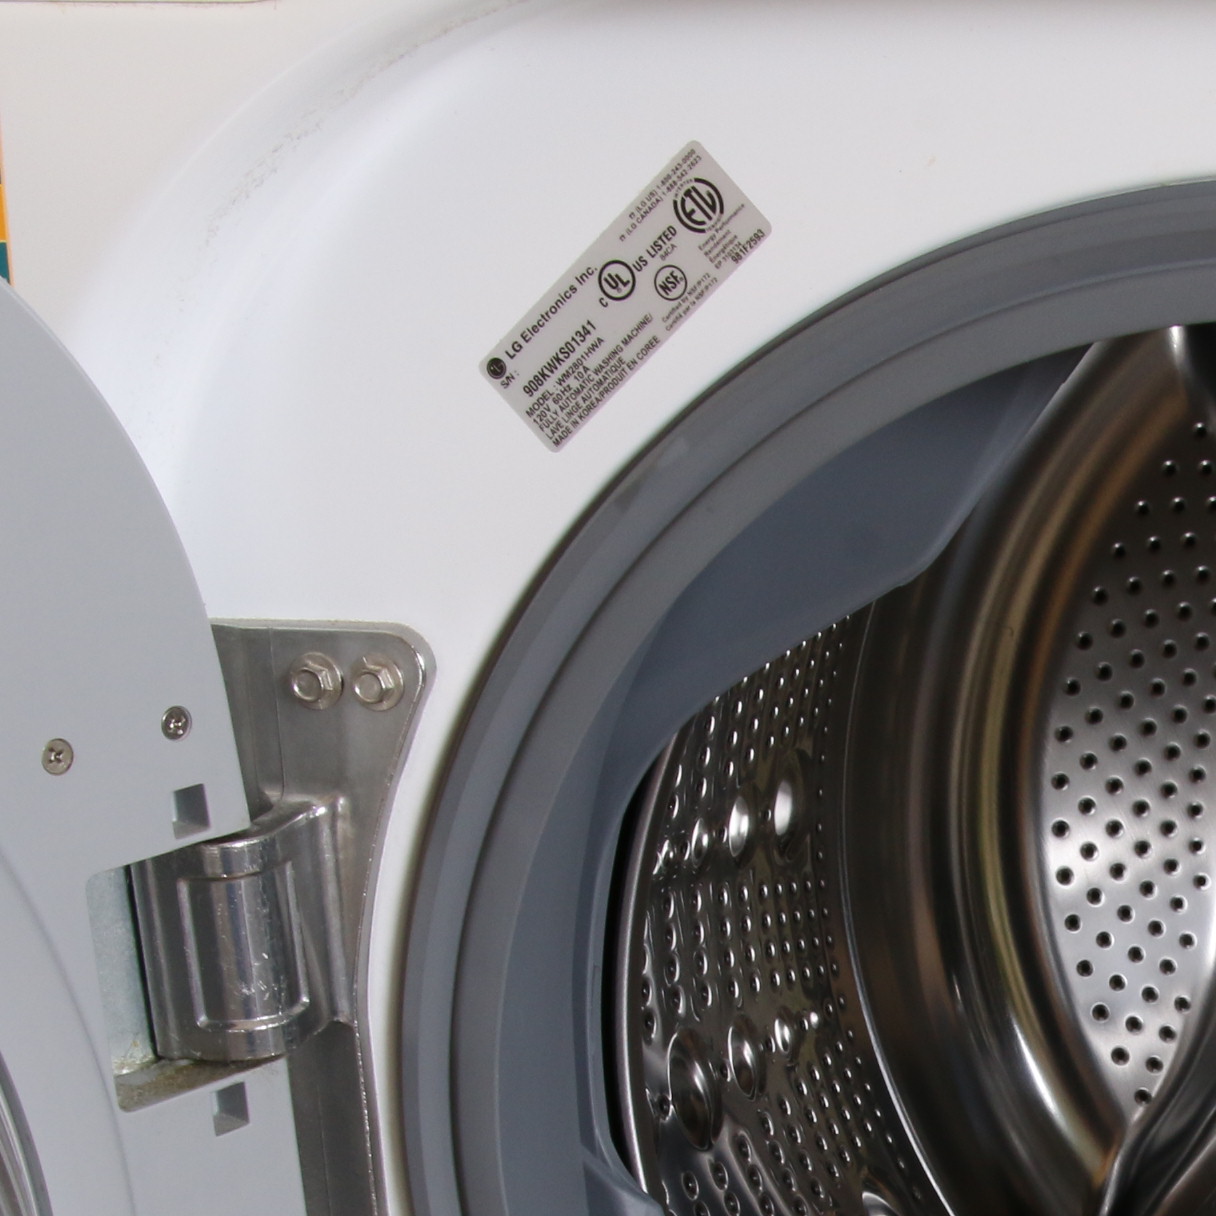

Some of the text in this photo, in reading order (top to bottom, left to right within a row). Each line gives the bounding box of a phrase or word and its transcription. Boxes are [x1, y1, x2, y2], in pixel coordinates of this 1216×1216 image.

[602, 272, 631, 293] UL
[631, 254, 649, 273] US
[645, 224, 678, 259] LISTED
[657, 269, 685, 296] NSF
[729, 228, 766, 265] 981F2593
[504, 266, 598, 360] LG Electronics Inc.
[499, 372, 516, 389] S/N
[522, 319, 597, 398] 908KWKS01341
[524, 388, 555, 418] MODEL
[554, 336, 605, 388] WM2801HWA
[537, 313, 653, 433] FULLY AUTOMATIC WASHING MACHINE/
[544, 355, 626, 441] LAVE LINGE AUTOMATIQUE
[551, 334, 661, 448] MADE IN KOREA/PRODUIT EN COREE
